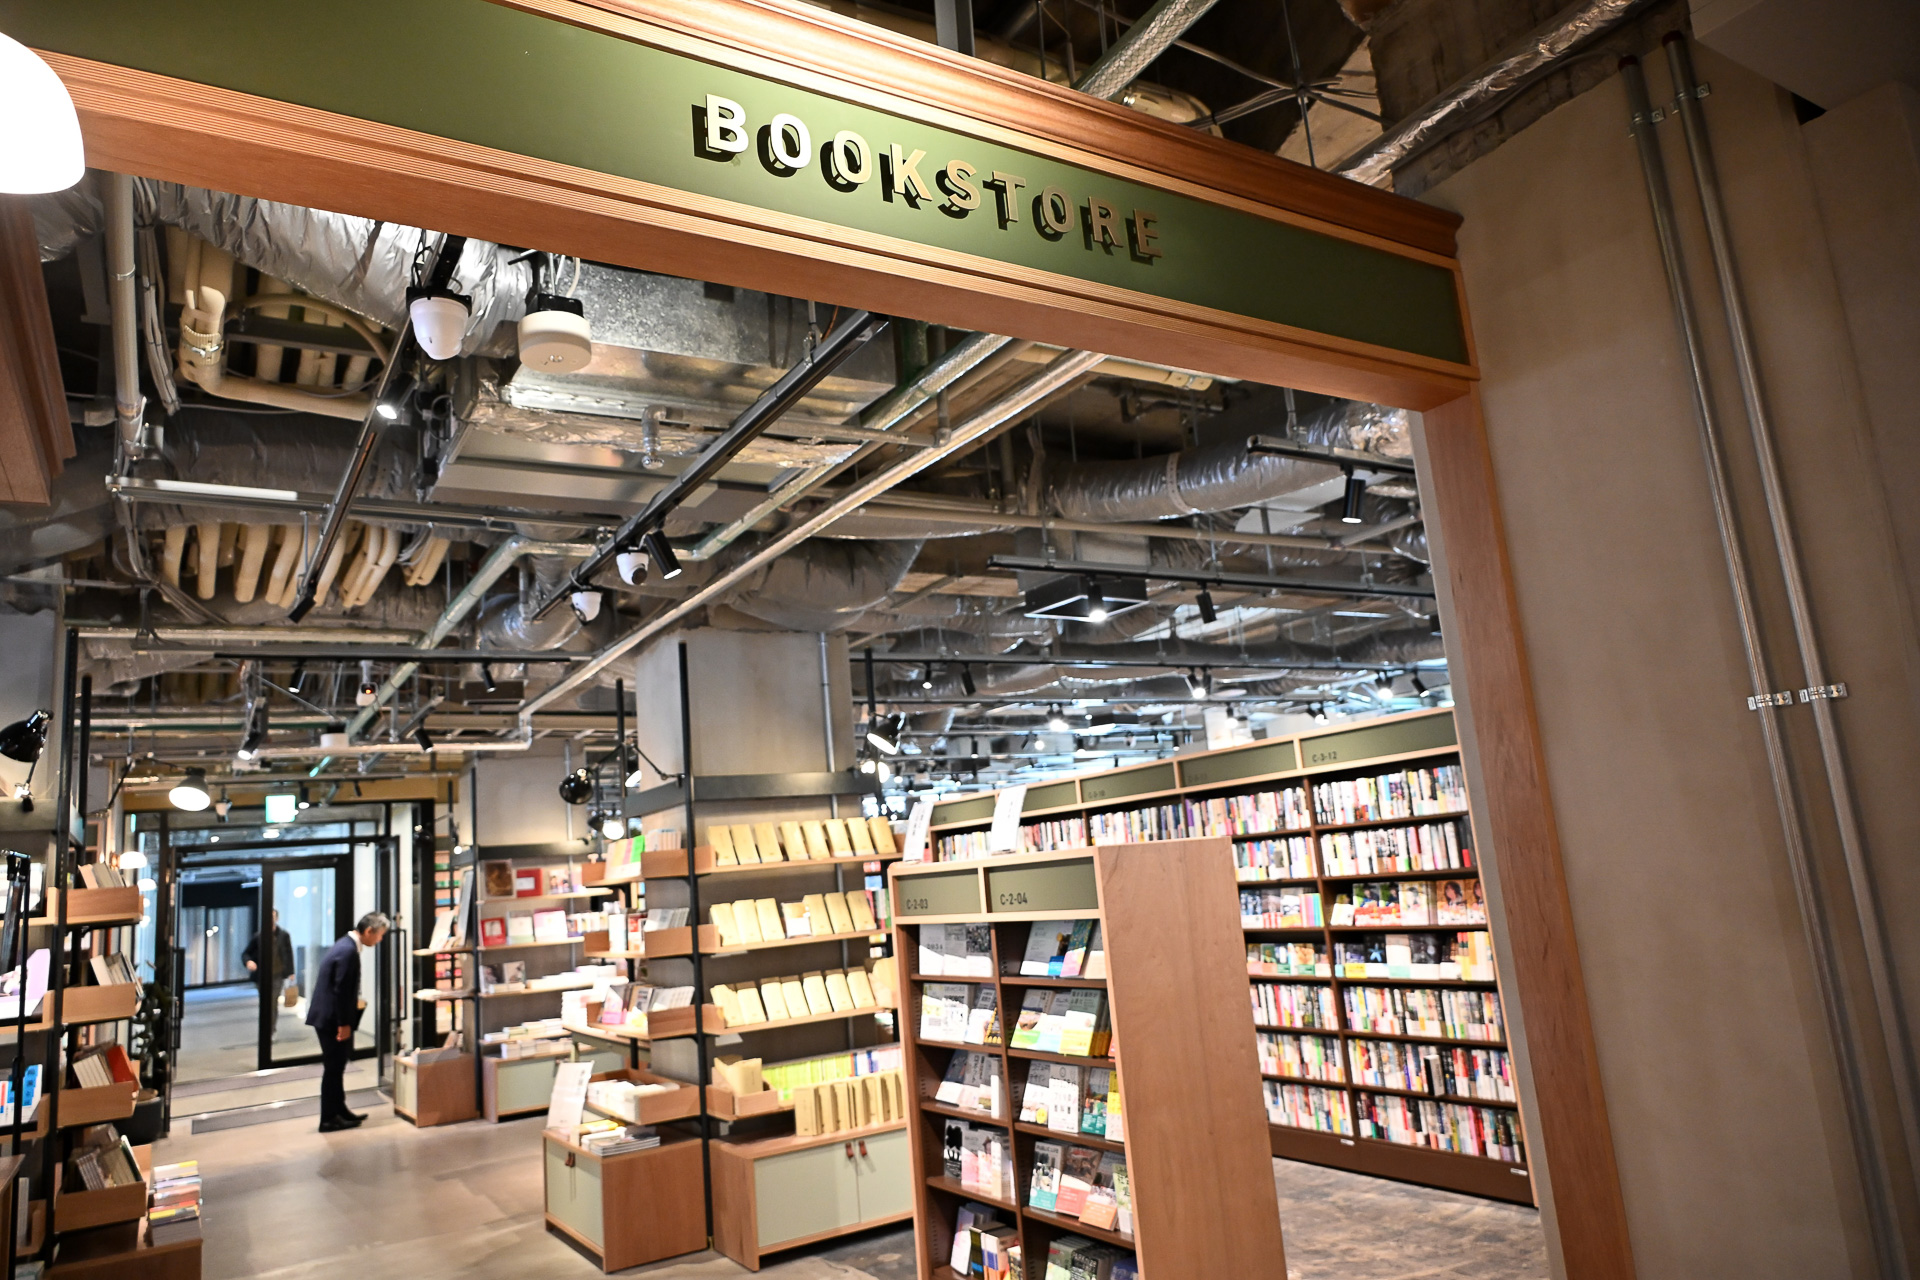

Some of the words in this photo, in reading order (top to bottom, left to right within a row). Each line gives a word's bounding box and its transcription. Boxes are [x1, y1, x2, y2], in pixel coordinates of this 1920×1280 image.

[703, 93, 1163, 259] BOOKSTORE
[1312, 750, 1337, 763] C-3-12
[906, 898, 929, 910] C-2-03
[999, 892, 1028, 906] C-2-04
